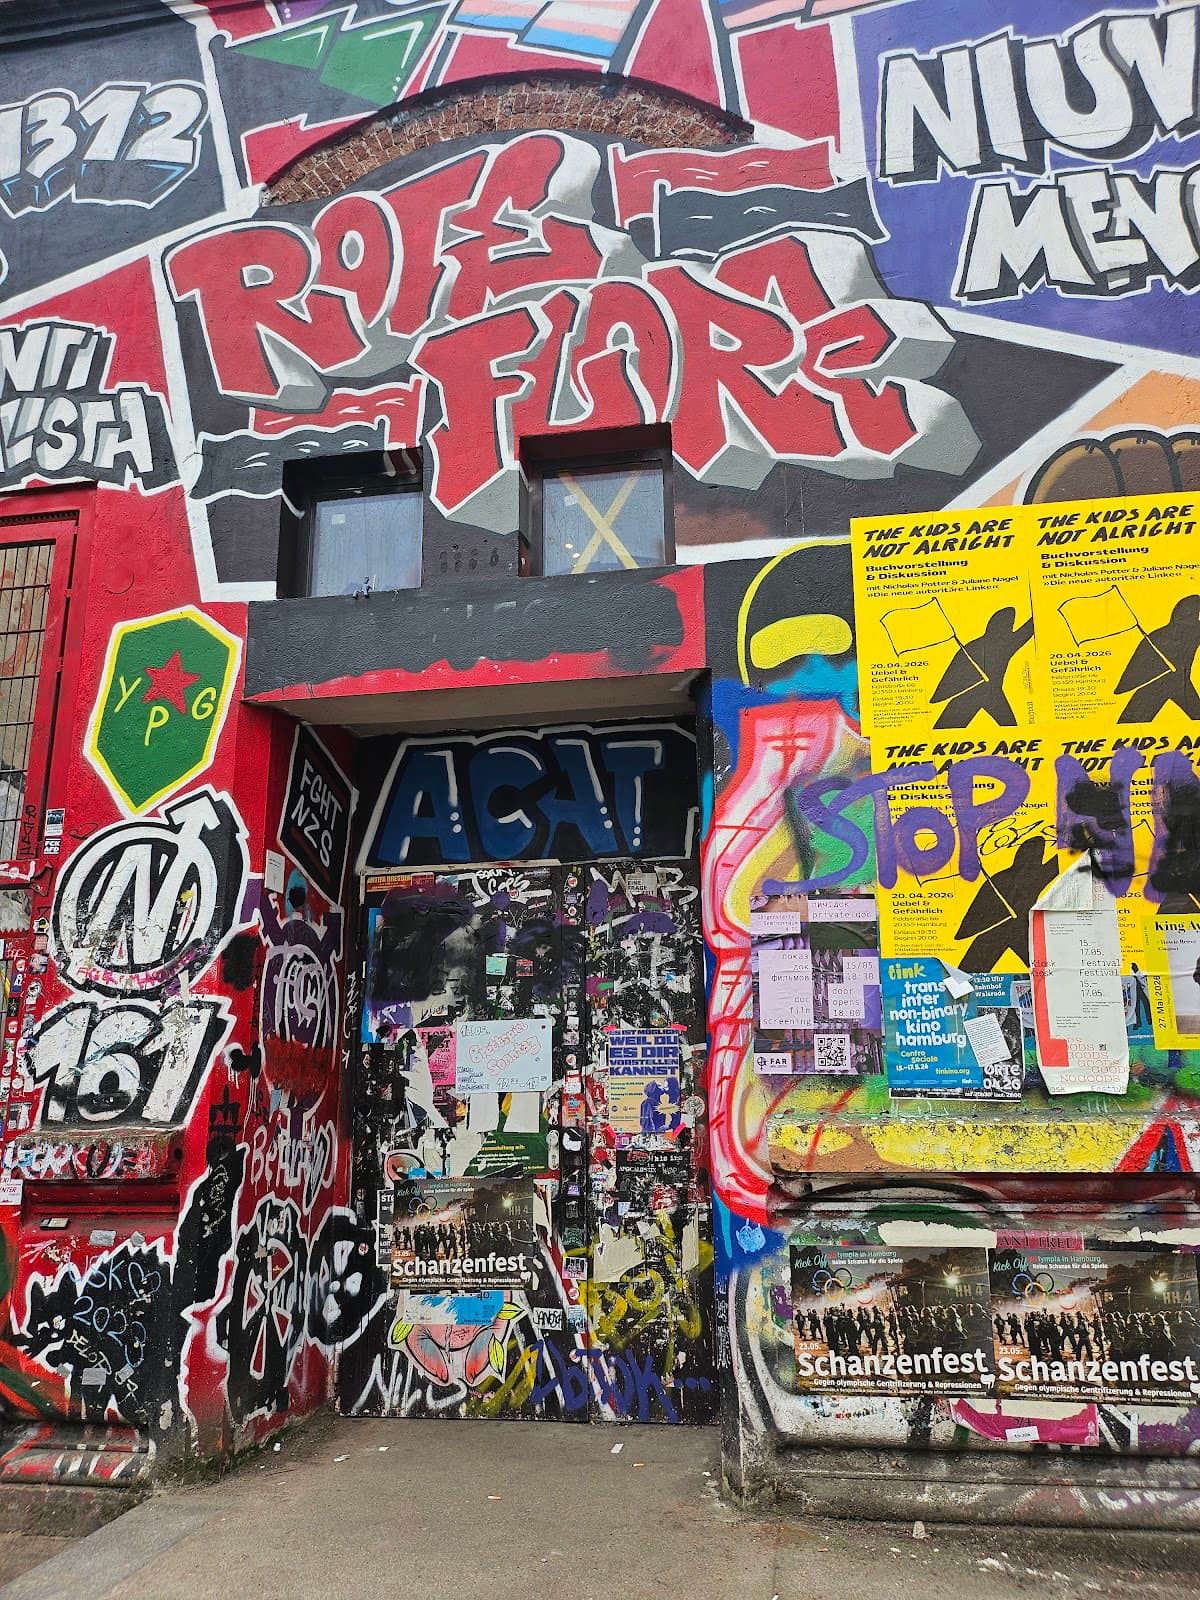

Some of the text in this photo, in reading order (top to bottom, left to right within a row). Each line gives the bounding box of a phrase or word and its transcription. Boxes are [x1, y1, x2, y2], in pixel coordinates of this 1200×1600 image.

[963, 170, 1200, 294] MEN
[165, 134, 600, 397] ROTE
[0, 390, 153, 473] LISTA
[1038, 505, 1195, 529] THE KIDS ARE
[864, 519, 1013, 542] THE KIDS ARE
[1037, 522, 1197, 546] NOT ALRIGHT
[863, 535, 1015, 559] NOT ALRIGHT
[1041, 547, 1149, 560] Buchvorstellung
[866, 560, 968, 572] Buchvorstellung
[1055, 557, 1127, 568] Diskussion
[879, 570, 947, 580] Diskussion
[1060, 570, 1098, 578] Nicholas
[1100, 568, 1130, 576] Potter
[1096, 574, 1145, 582] autoritäre
[884, 582, 919, 590] Nicholas
[916, 586, 964, 595] autoritäre
[885, 740, 1043, 759] THE KIDS ARE
[1061, 736, 1170, 755] THE KIDS
[762, 756, 1032, 895] STOP
[1156, 921, 1186, 933] King
[888, 963, 927, 980] tink
[1080, 969, 1120, 977] Festival
[904, 981, 947, 994] trans
[832, 999, 860, 1007] opens
[902, 994, 940, 1008] inter
[890, 1003, 968, 1021] non-binary
[763, 1018, 812, 1027] screening
[906, 1020, 941, 1034] kino
[610, 1036, 678, 1045] WEIL DU
[896, 1032, 967, 1048] hamburg
[610, 1047, 679, 1058] ES DIR
[33, 1004, 208, 1123] 161
[610, 1067, 678, 1076] KANNST
[392, 1252, 527, 1277] Schanzenfest
[794, 1253, 828, 1269] Kick Off
[993, 1257, 1028, 1272] Kick Off
[1071, 1256, 1101, 1264] Hamburg
[955, 1285, 972, 1297] HH
[1163, 1291, 1177, 1305] HH
[999, 1347, 1023, 1355] 23.05.
[798, 1346, 989, 1377] Schanzenfest
[998, 1354, 1199, 1383] Schanzenfest
[814, 1379, 835, 1387] Gegen
[836, 1379, 876, 1388] olympische
[935, 1381, 982, 1390] Repressionen
[1015, 1383, 1037, 1391] Gegen
[1039, 1385, 1079, 1394] olympische
[1143, 1389, 1191, 1397] Repressionen
